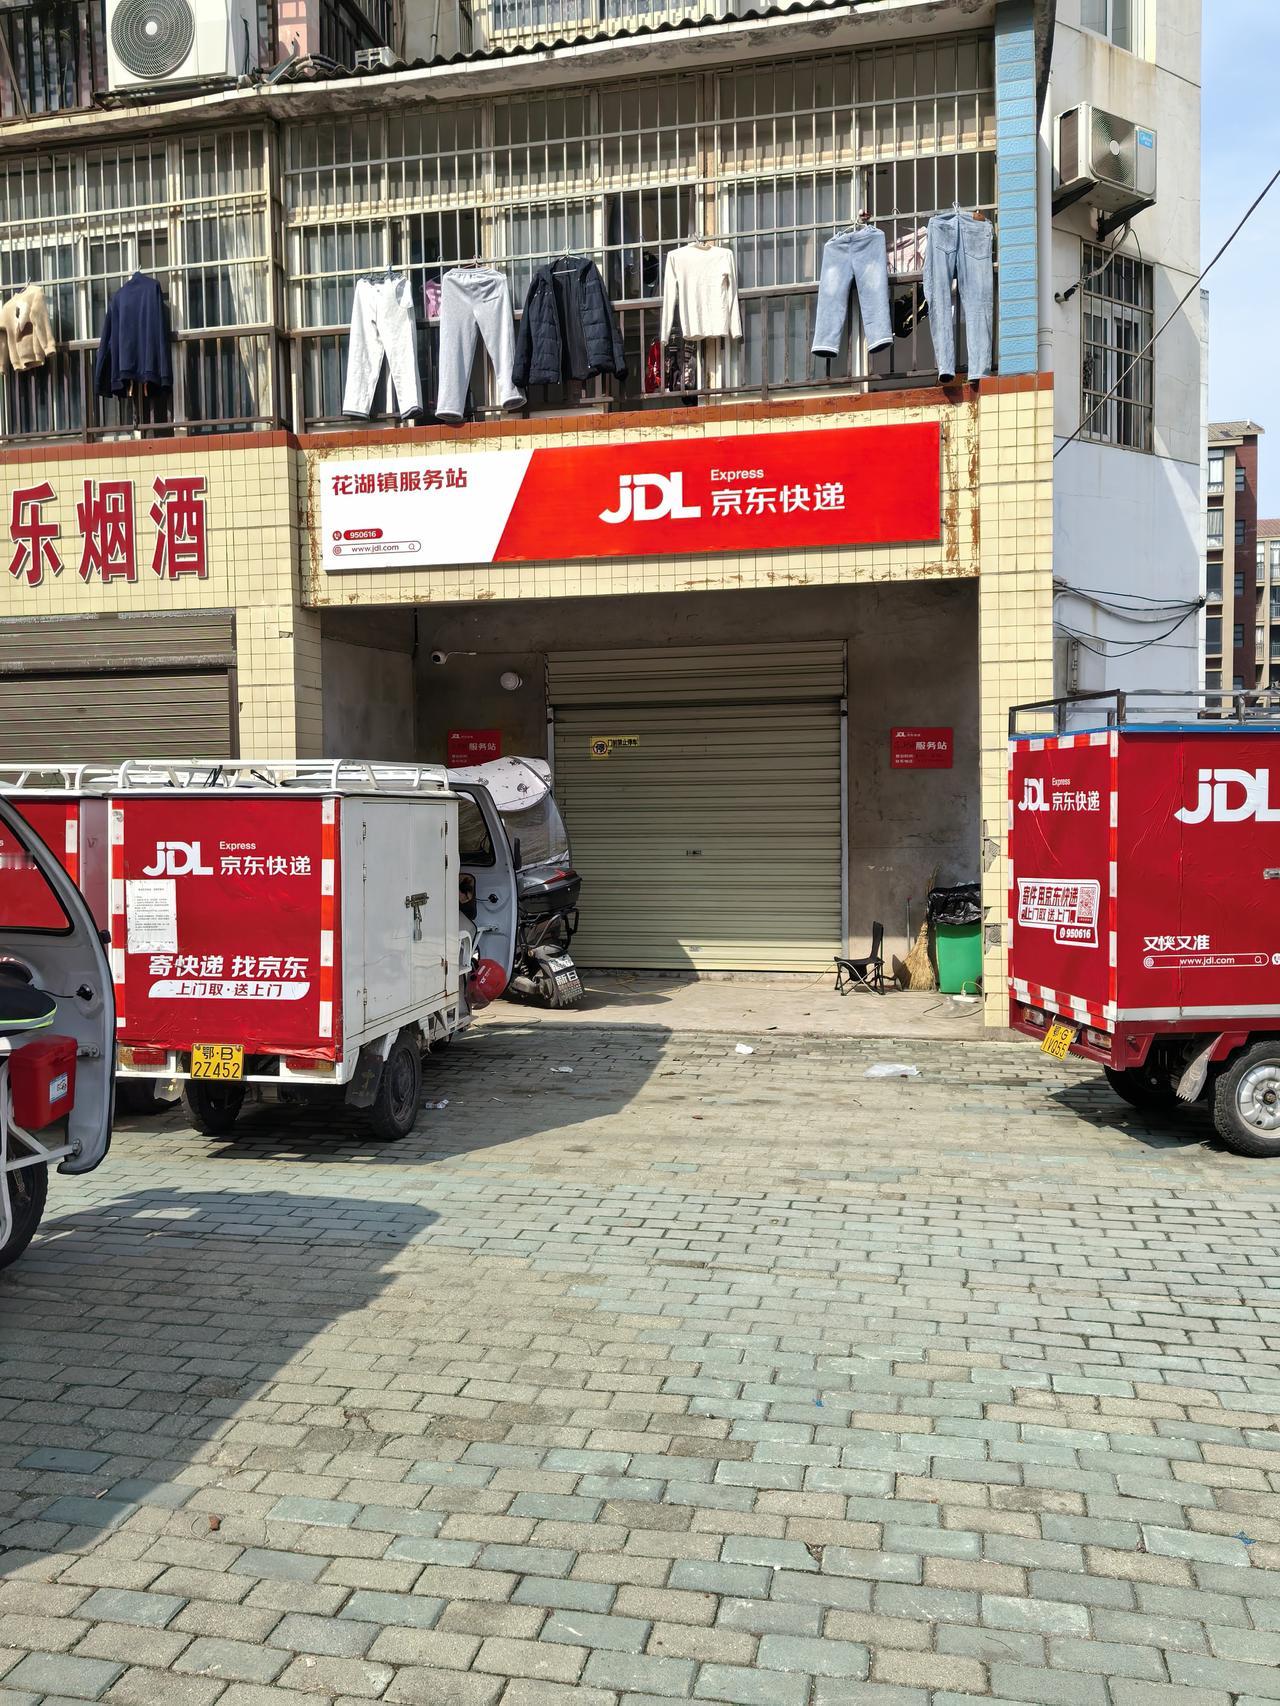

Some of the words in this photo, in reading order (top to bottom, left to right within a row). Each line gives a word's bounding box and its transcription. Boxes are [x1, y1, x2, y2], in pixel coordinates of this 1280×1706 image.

[331, 467, 468, 496] 花湖镇服务站
[710, 467, 764, 483] Express
[598, 471, 702, 524] JDL
[711, 484, 845, 517] 京东快递
[8, 474, 209, 587] 乐烟酒
[350, 531, 376, 539] 950616
[352, 544, 399, 553] www.jdl.com
[468, 742, 497, 751] 服务站
[915, 741, 948, 750] 服务站
[1052, 777, 1071, 787] Express
[1017, 778, 1050, 812] JDL
[1052, 790, 1100, 812] 京东快递
[219, 841, 256, 850] Express
[142, 841, 214, 876] JDL
[220, 855, 311, 876] 京东快递
[1066, 929, 1091, 939] 950616
[1143, 934, 1211, 952] 又快又准
[149, 955, 224, 977] 寄快递
[231, 955, 309, 978] 找京东
[1180, 957, 1235, 967] www.jdl.com
